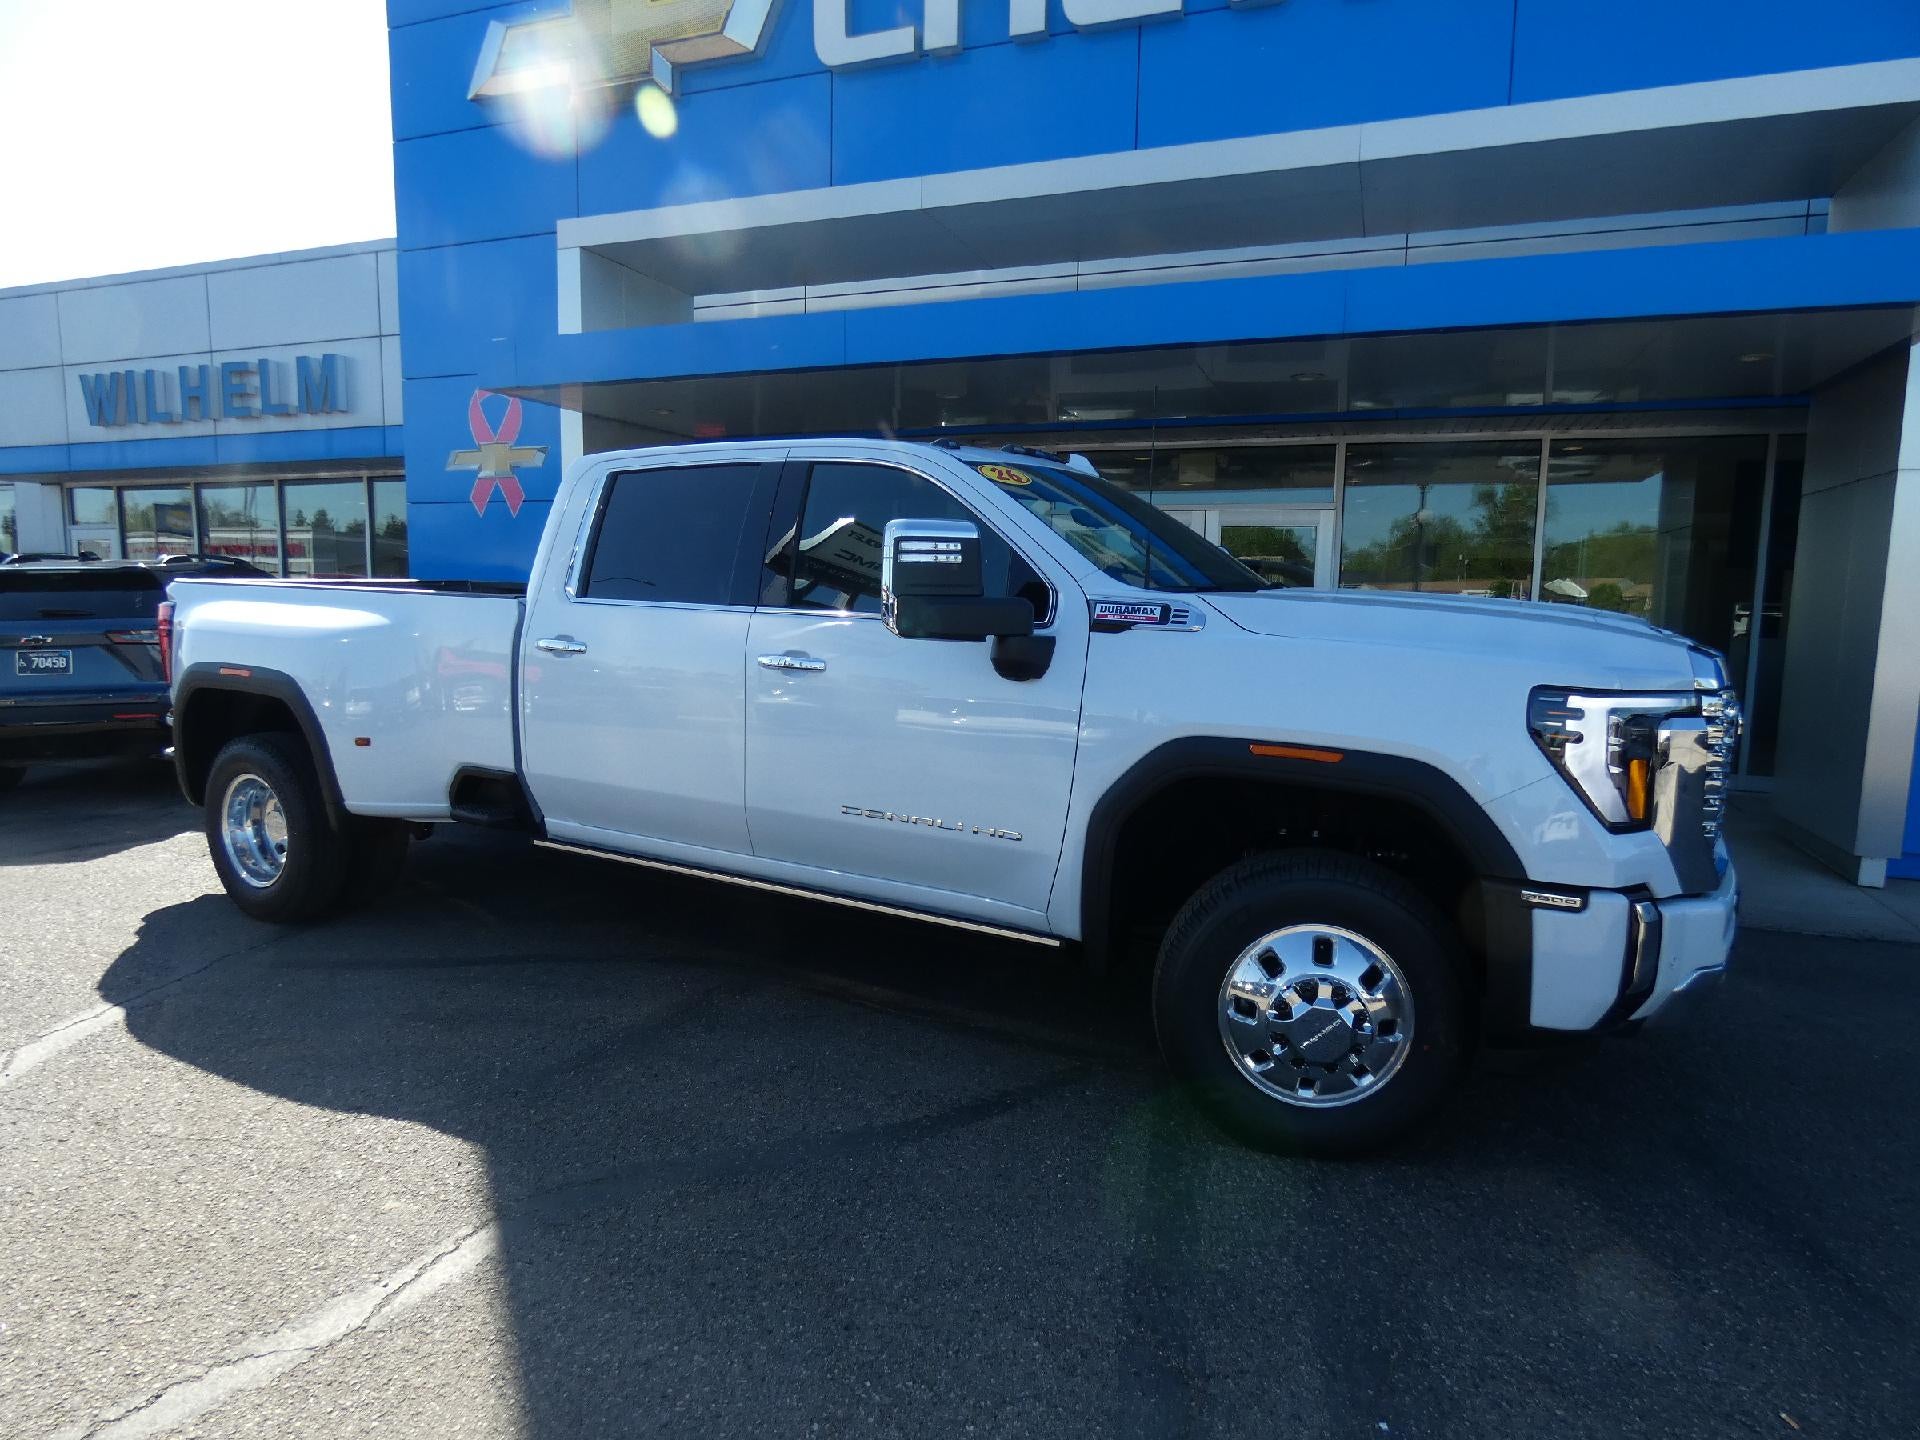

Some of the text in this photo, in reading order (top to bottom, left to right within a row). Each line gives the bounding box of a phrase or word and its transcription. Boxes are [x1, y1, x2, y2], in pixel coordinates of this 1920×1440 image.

[79, 353, 350, 426] WILHELM
[1099, 604, 1158, 616] DURAMAX
[841, 805, 1023, 841] DENALI HD
